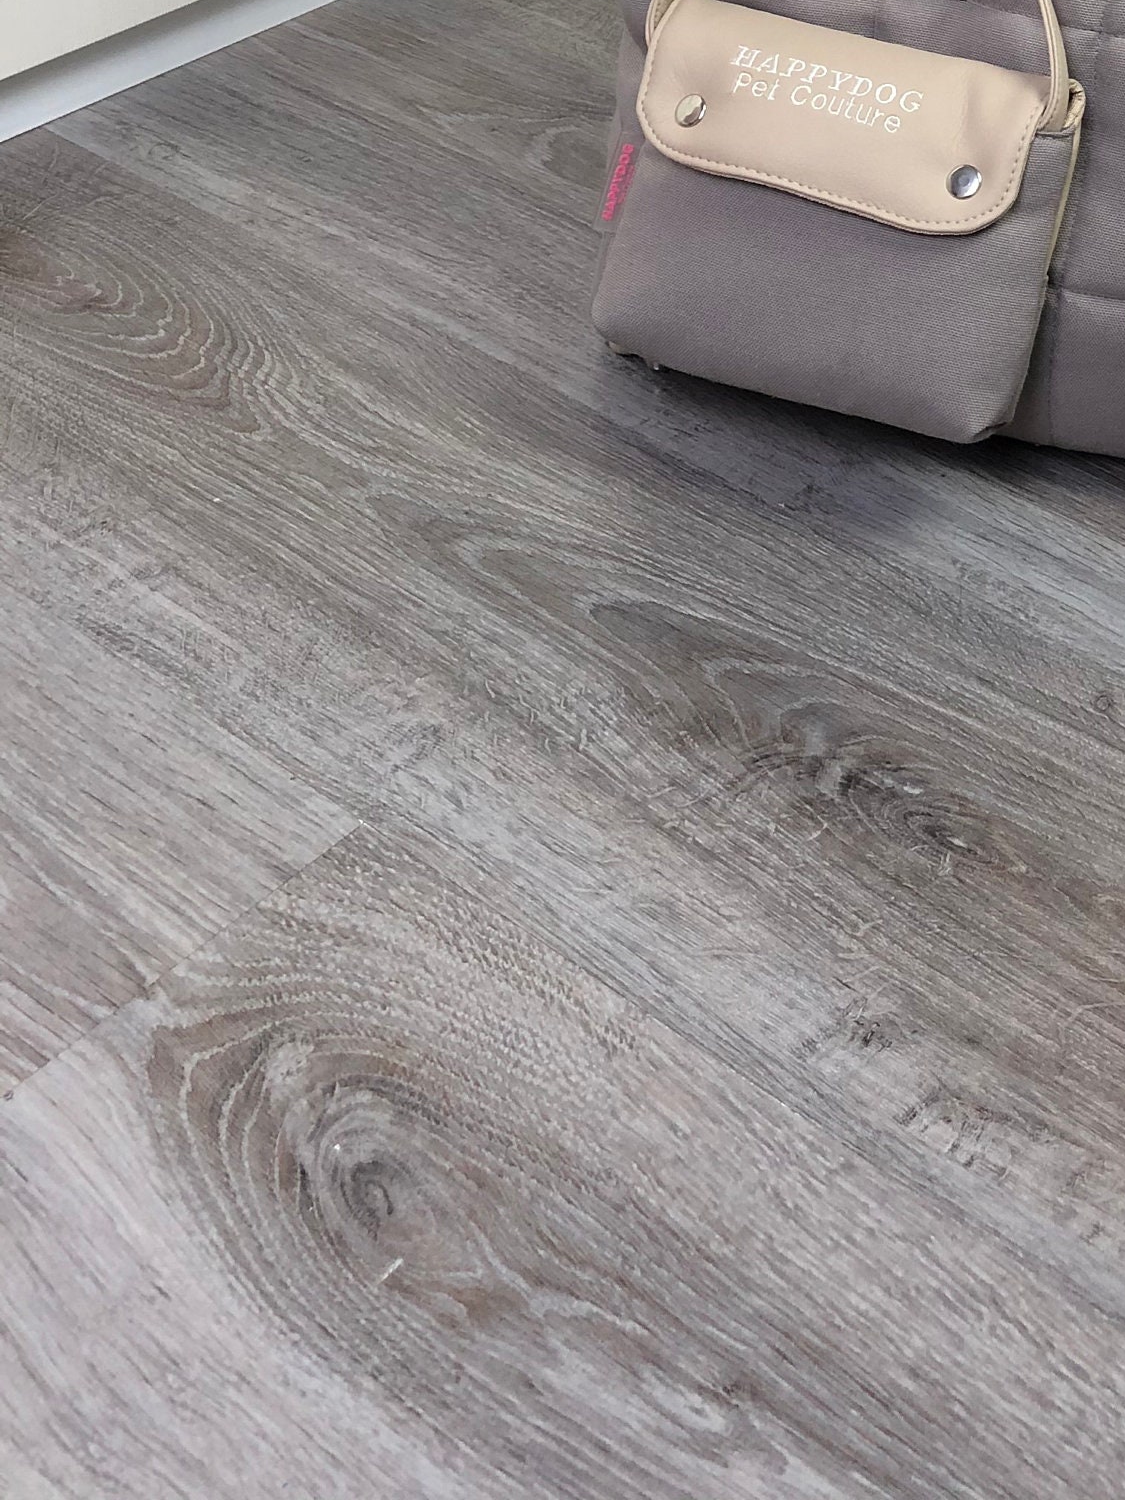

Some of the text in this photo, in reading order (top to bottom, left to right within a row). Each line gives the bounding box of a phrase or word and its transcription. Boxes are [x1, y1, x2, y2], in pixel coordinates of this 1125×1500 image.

[729, 45, 924, 112] HAPPYDOG
[733, 72, 901, 133] Pet Couture
